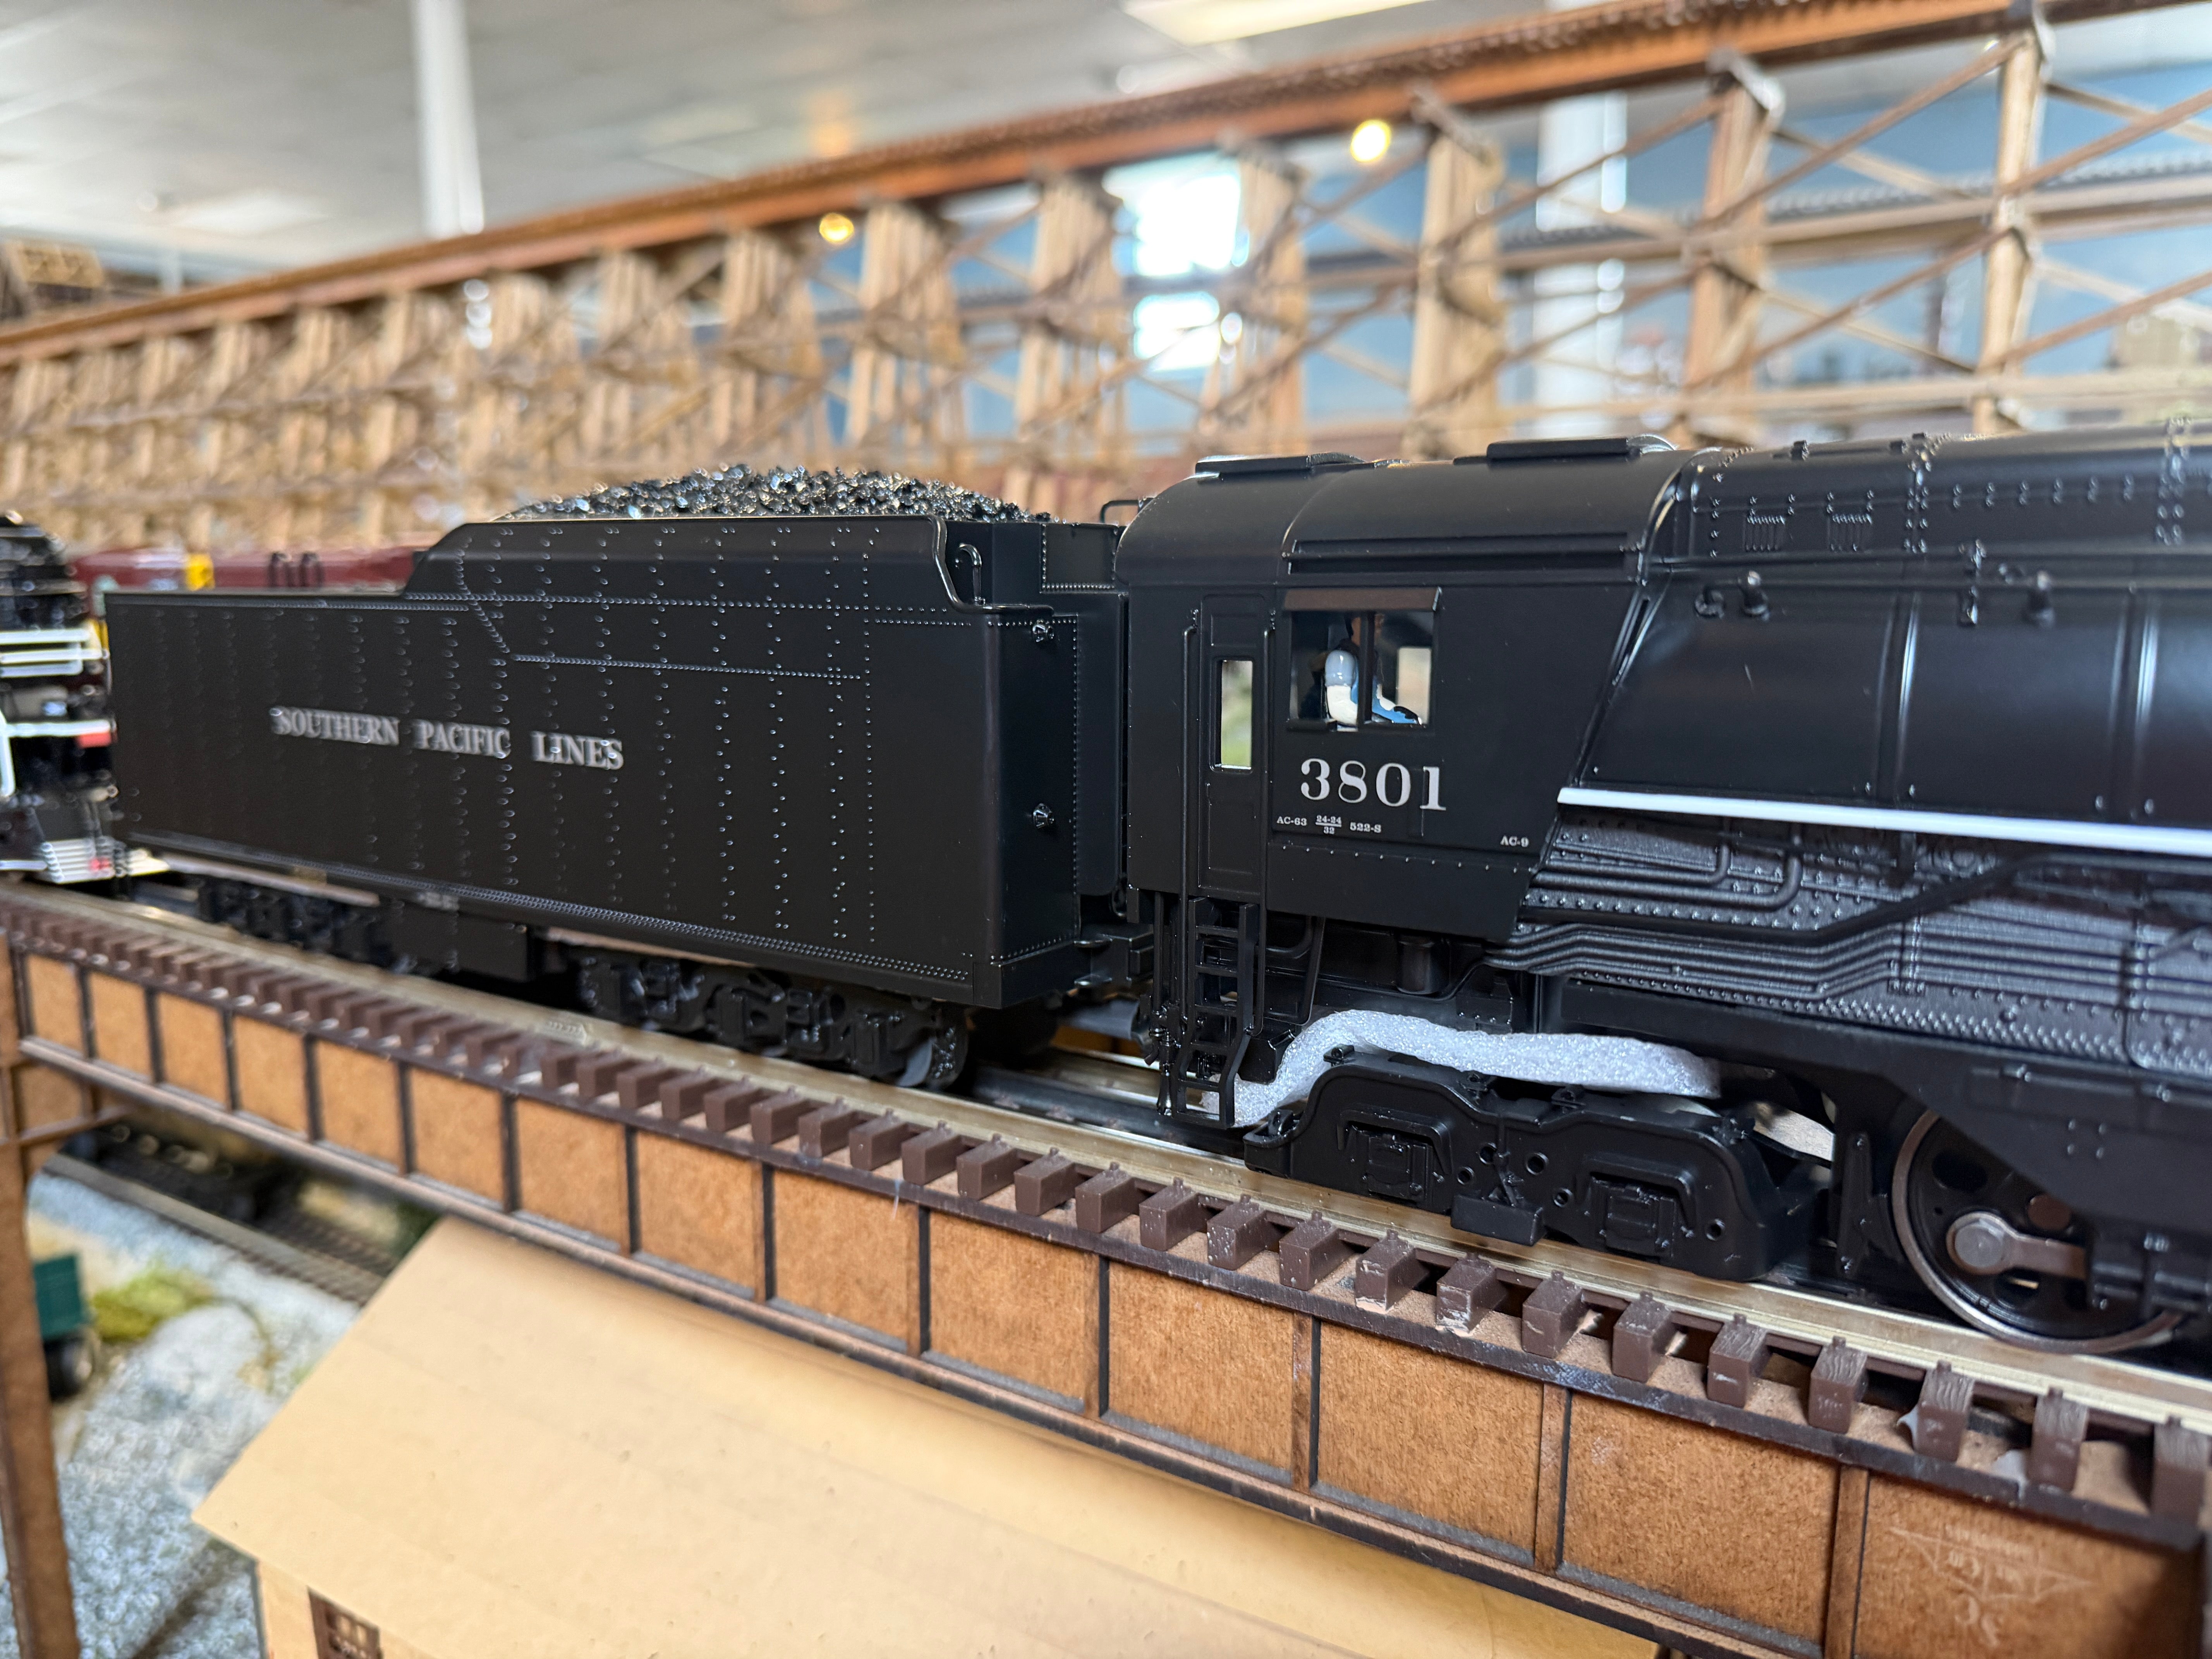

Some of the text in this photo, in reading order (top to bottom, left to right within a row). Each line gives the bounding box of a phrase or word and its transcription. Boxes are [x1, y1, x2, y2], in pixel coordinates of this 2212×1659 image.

[271, 706, 624, 770] SOUTHERN PACIFIC LINES
[1301, 758, 1446, 811] 3801
[1277, 815, 1381, 833] AC-63 24-24 522-S
[1324, 826, 1334, 835] 32
[1500, 835, 1529, 847] AC-9
